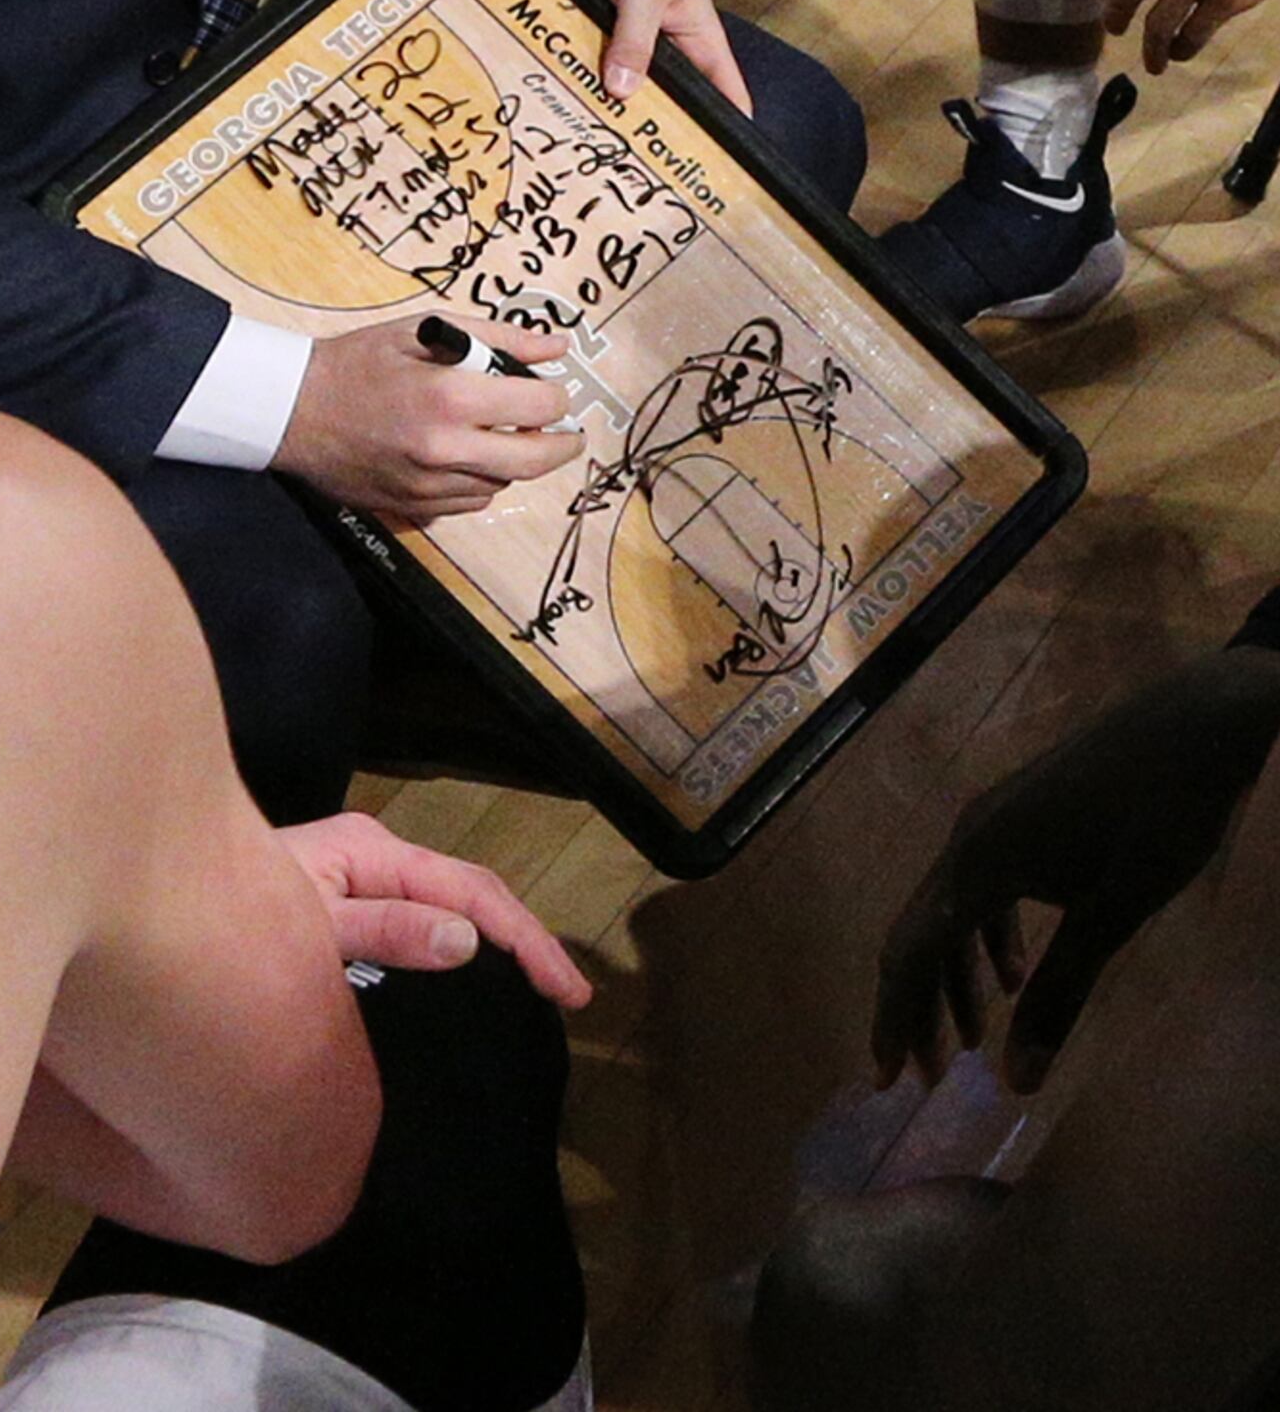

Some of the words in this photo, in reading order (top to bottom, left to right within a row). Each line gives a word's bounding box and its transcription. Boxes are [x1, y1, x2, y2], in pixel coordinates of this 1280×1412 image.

[136, 63, 328, 218] GEORGIA
[522, 73, 596, 141] Cremins
[633, 118, 727, 215] Pavilion
[842, 490, 993, 641] YELLOW
[680, 634, 840, 804] JACKETS
